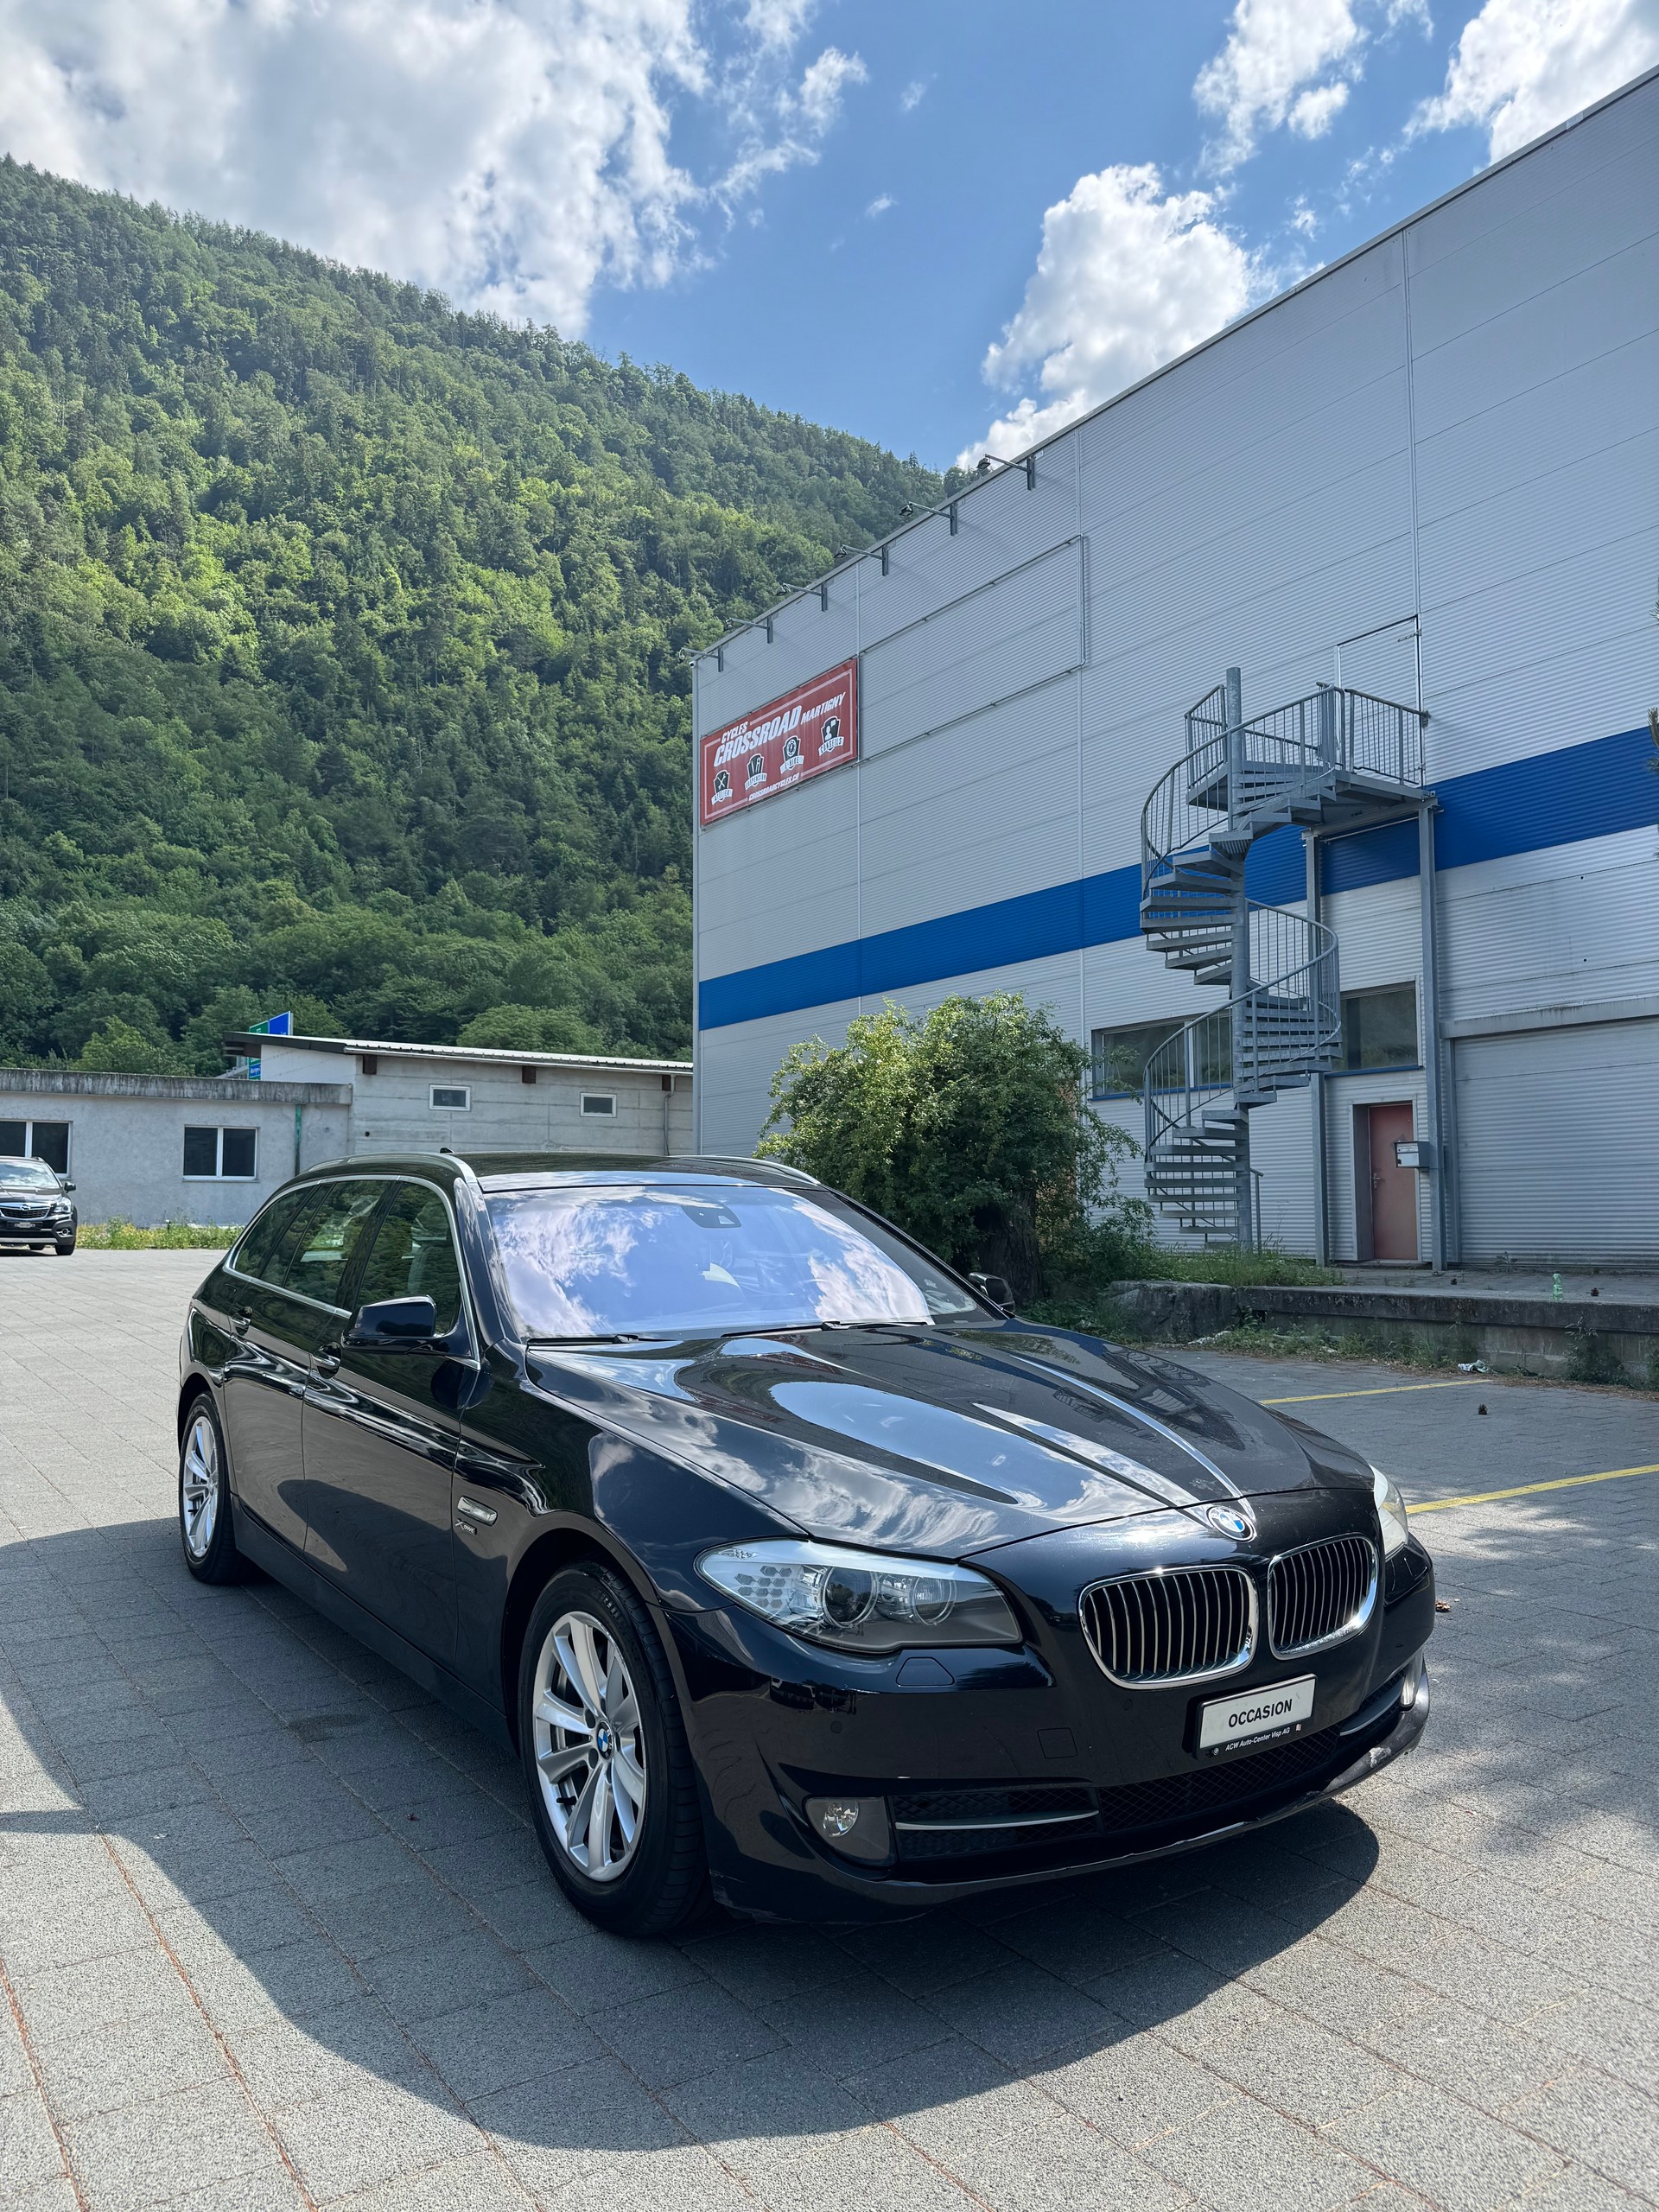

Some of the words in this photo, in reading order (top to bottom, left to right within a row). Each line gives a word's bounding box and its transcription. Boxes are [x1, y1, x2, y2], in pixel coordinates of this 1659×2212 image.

[714, 704, 803, 767] CROSSROAD
[800, 691, 847, 725] MARTIGNY
[721, 721, 748, 744] CYCLES
[1228, 1698, 1293, 1728] OCCASION
[1224, 1741, 1240, 1751] ACW
[1239, 1733, 1271, 1747] Auto-Center
[1271, 1730, 1282, 1738] Visp
[1281, 1726, 1291, 1735] AG
